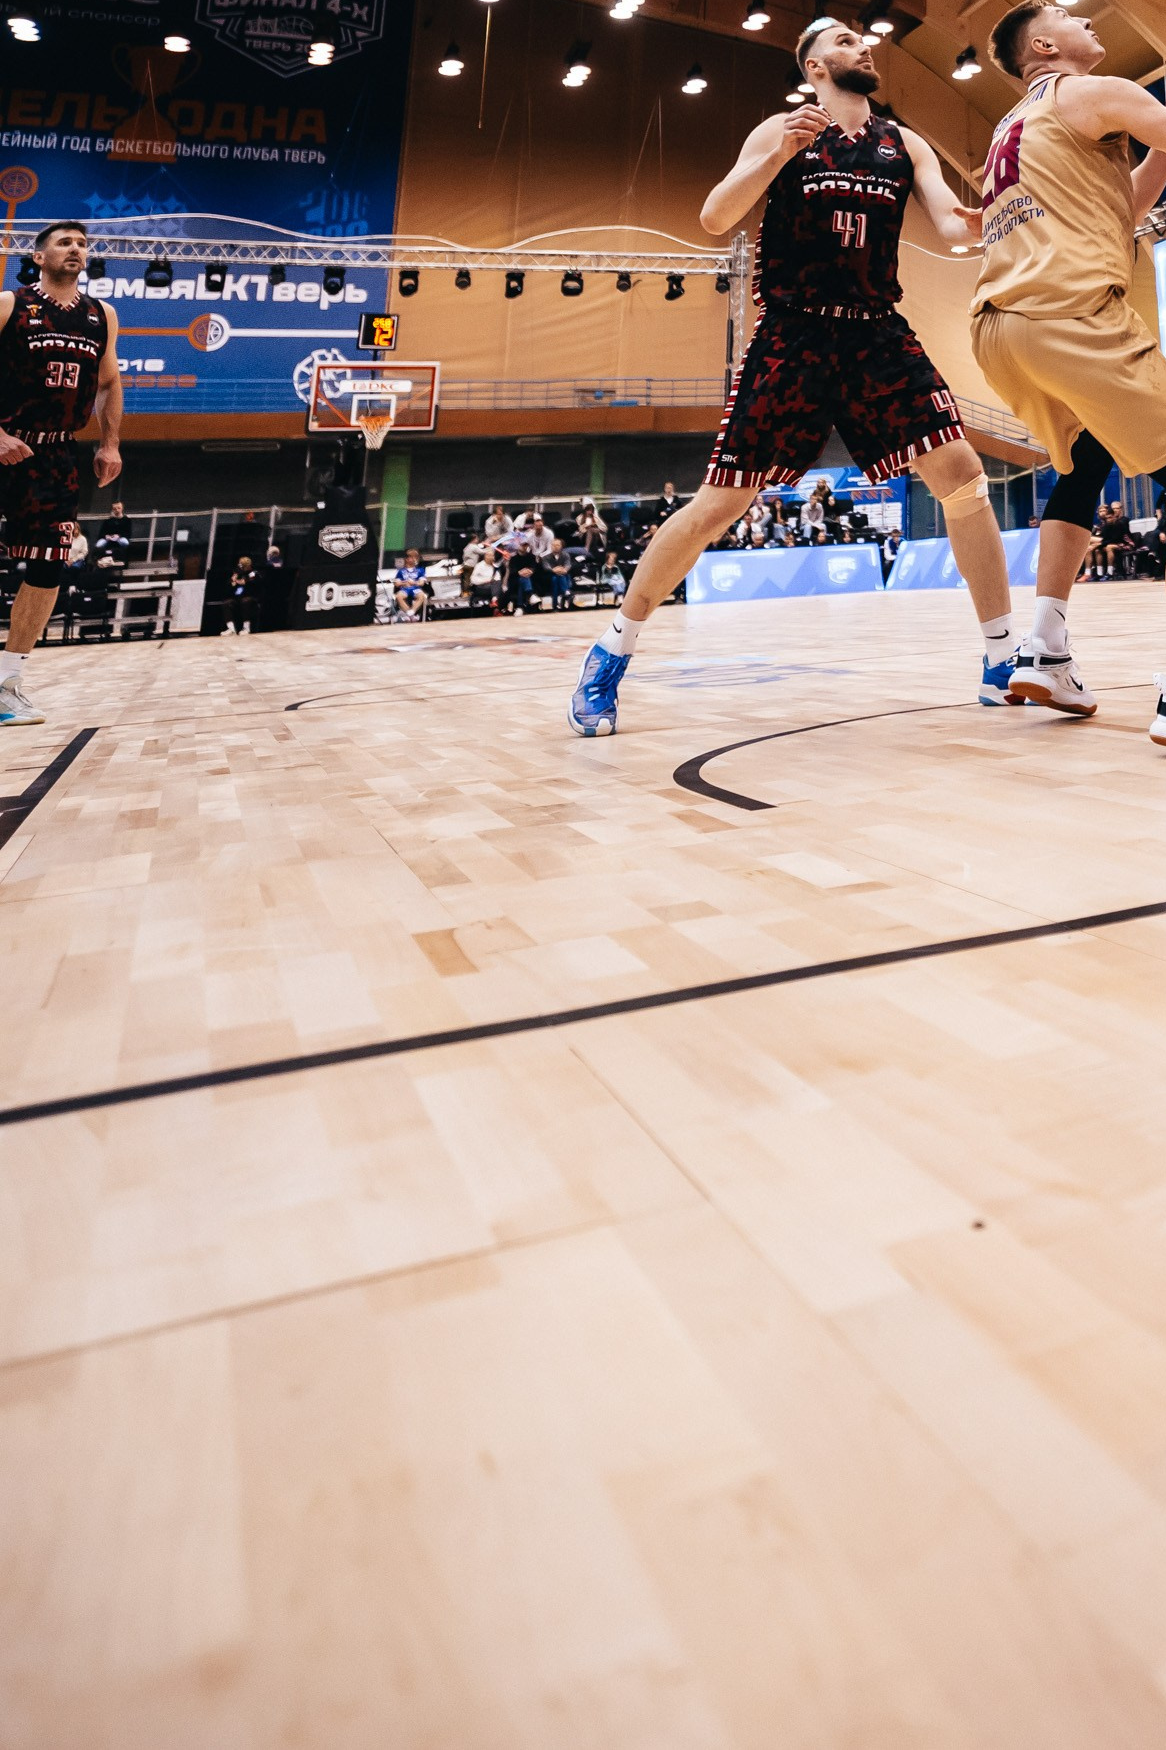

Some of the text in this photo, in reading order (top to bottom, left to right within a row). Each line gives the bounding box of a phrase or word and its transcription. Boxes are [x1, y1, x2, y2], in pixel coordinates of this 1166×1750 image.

[167, 98, 328, 146] ОДНА
[61, 133, 91, 154] ГОД
[94, 135, 229, 161] БАСКЕТБОЛЬНОГО
[232, 145, 280, 163] КЛУБА
[283, 147, 327, 167] ТВЕРЬ
[802, 179, 898, 207] РЯЗАНЬ
[832, 210, 867, 249] 41
[373, 329, 394, 347] 12
[44, 361, 82, 390] 33
[117, 358, 165, 372] 016
